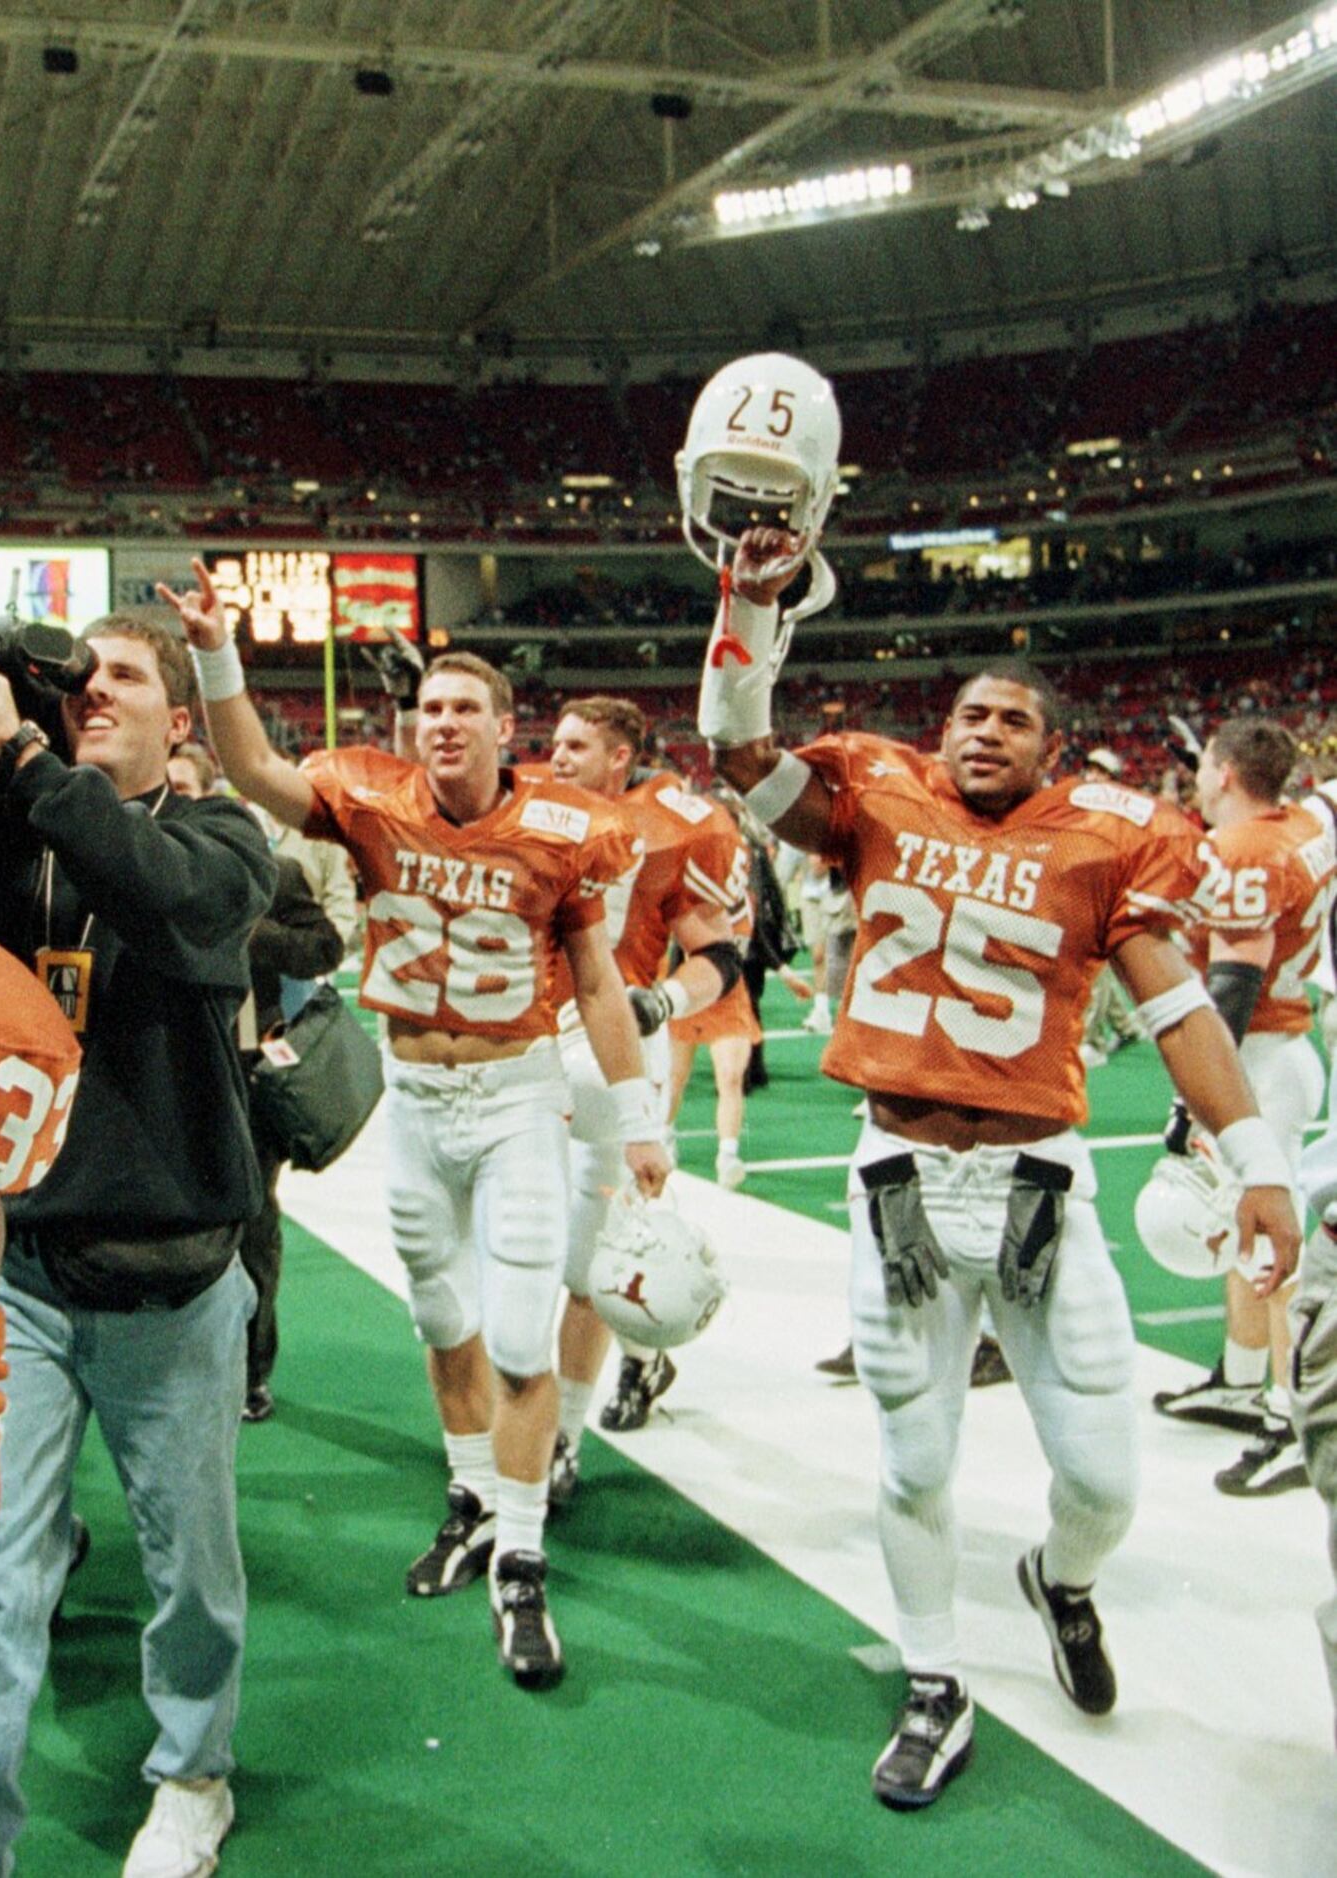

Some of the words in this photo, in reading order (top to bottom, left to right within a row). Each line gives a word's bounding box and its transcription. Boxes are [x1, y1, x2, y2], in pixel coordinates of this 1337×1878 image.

[726, 383, 796, 438] 25
[395, 849, 514, 908] TEXAS
[893, 830, 1043, 912] TEXAS
[362, 889, 536, 1022] 28
[847, 879, 1065, 1059] 25
